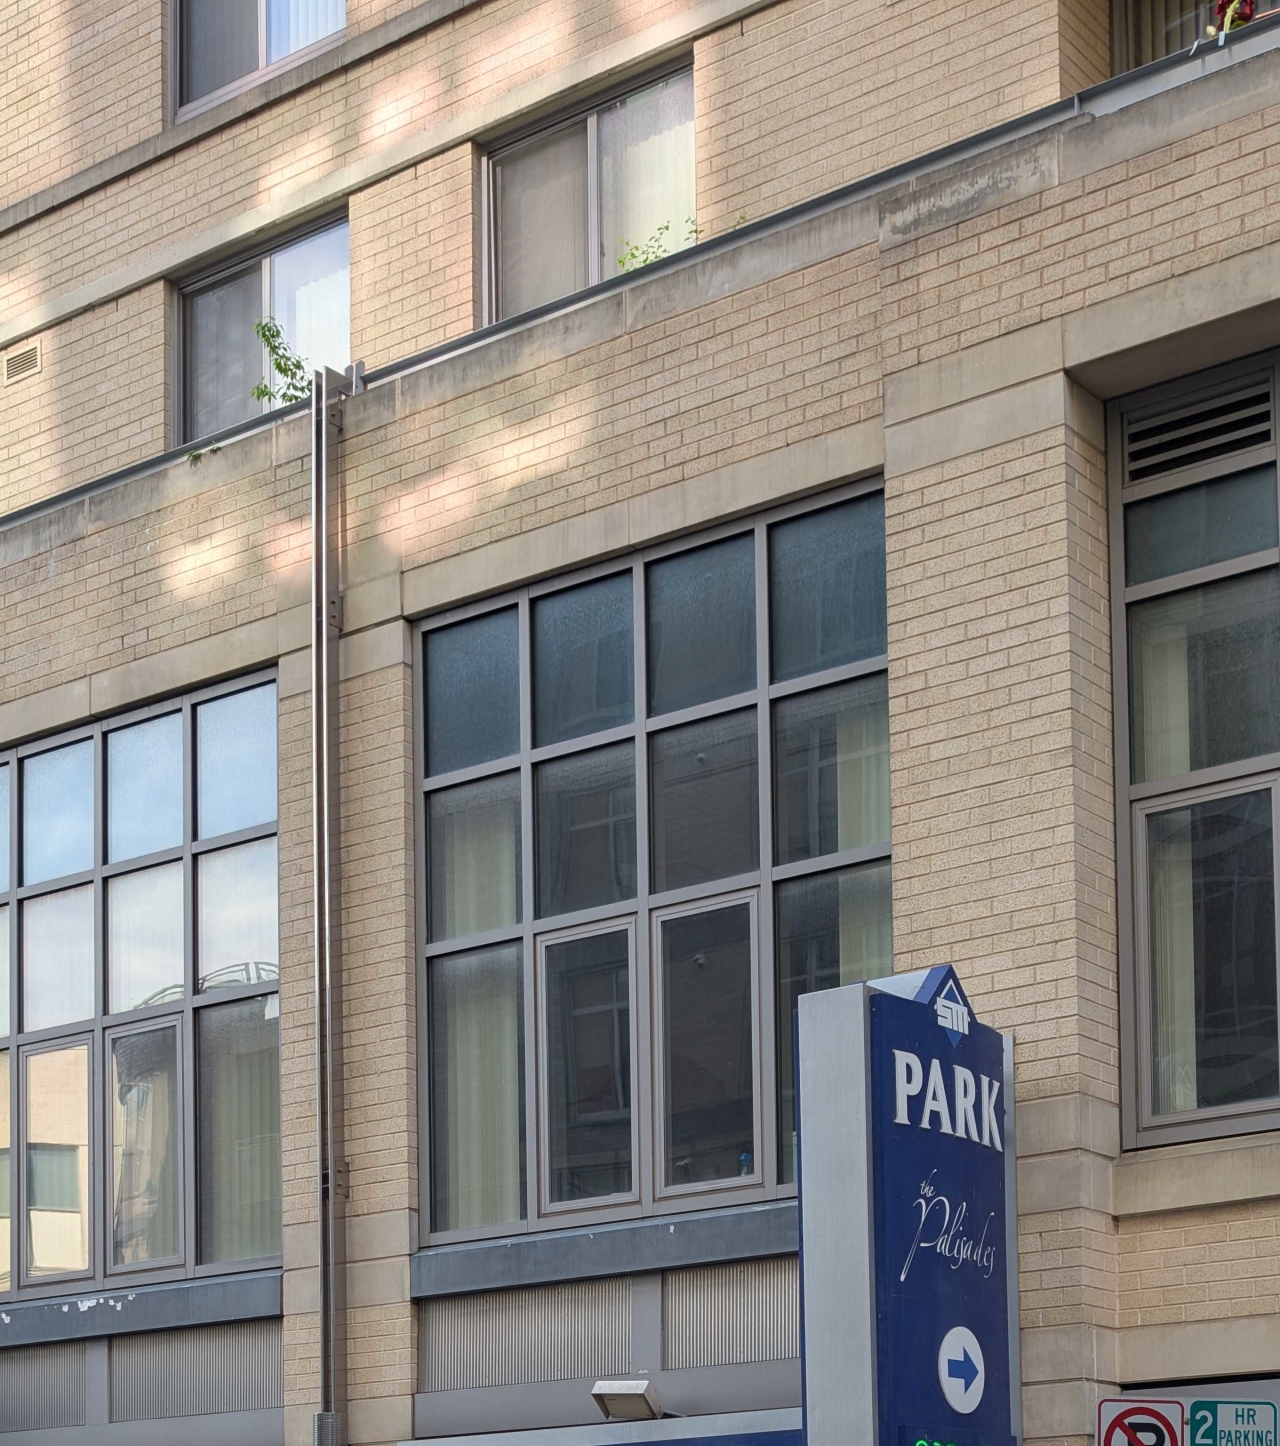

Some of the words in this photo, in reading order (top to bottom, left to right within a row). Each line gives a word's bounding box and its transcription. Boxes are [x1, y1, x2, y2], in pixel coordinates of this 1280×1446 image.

[892, 1049, 1004, 1152] PARK
[920, 1169, 937, 1197] the
[900, 1196, 996, 1282] Palisades
[1194, 1409, 1213, 1445] 2
[1234, 1407, 1257, 1426] HR
